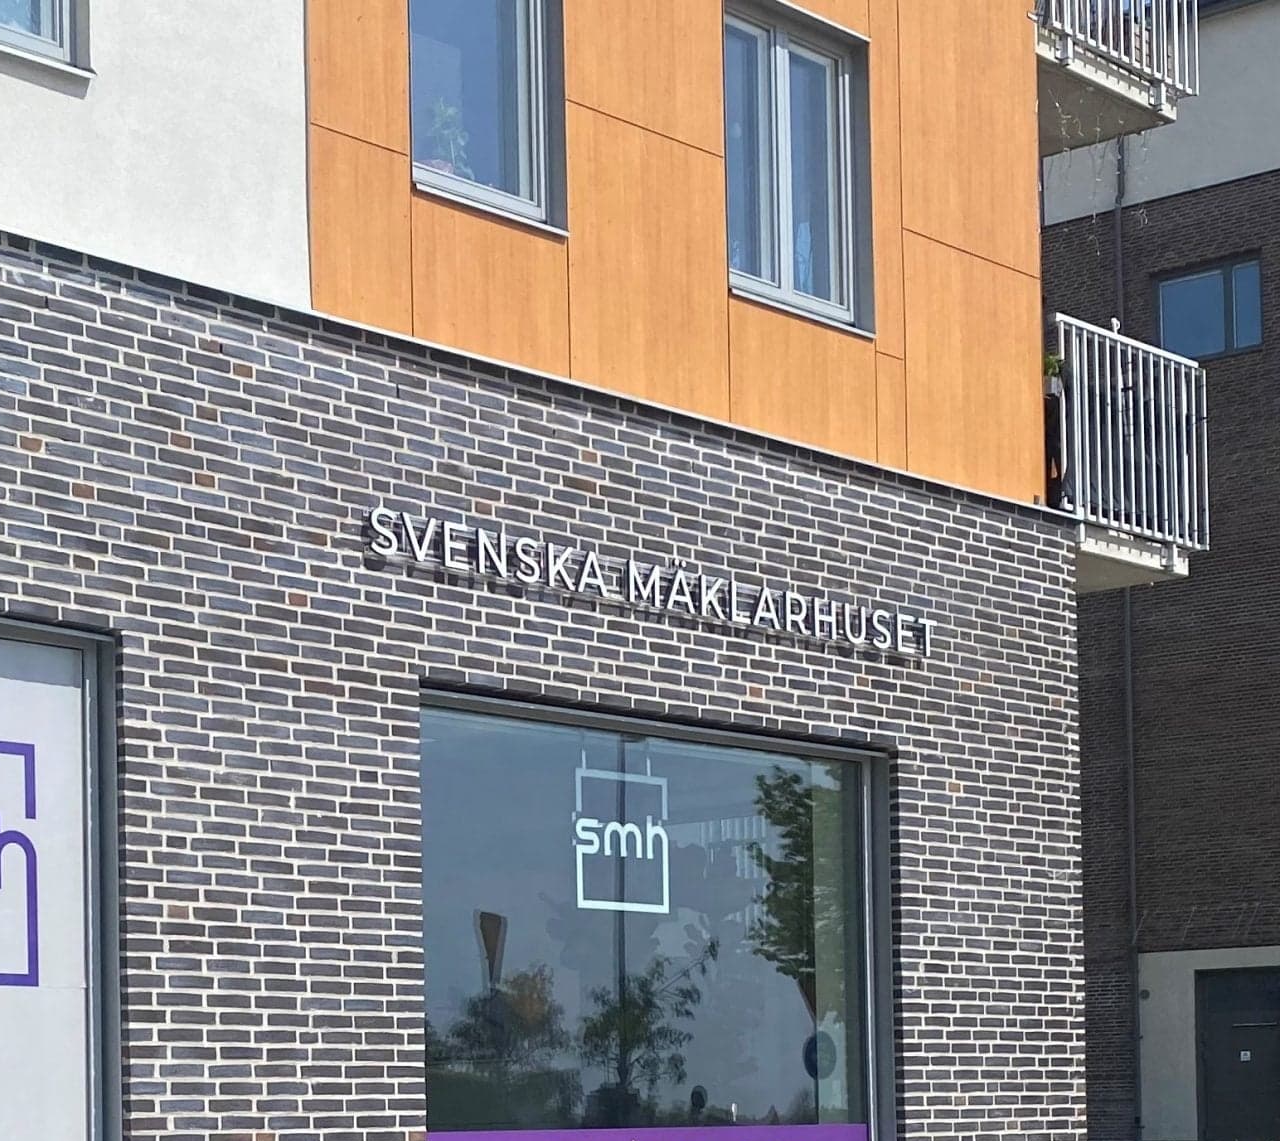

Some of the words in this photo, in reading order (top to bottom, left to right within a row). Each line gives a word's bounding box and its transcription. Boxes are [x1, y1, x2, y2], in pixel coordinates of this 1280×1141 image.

[369, 506, 608, 599] SVENSKA
[626, 557, 938, 658] MÄKLARHUSET
[575, 815, 668, 859] smh
